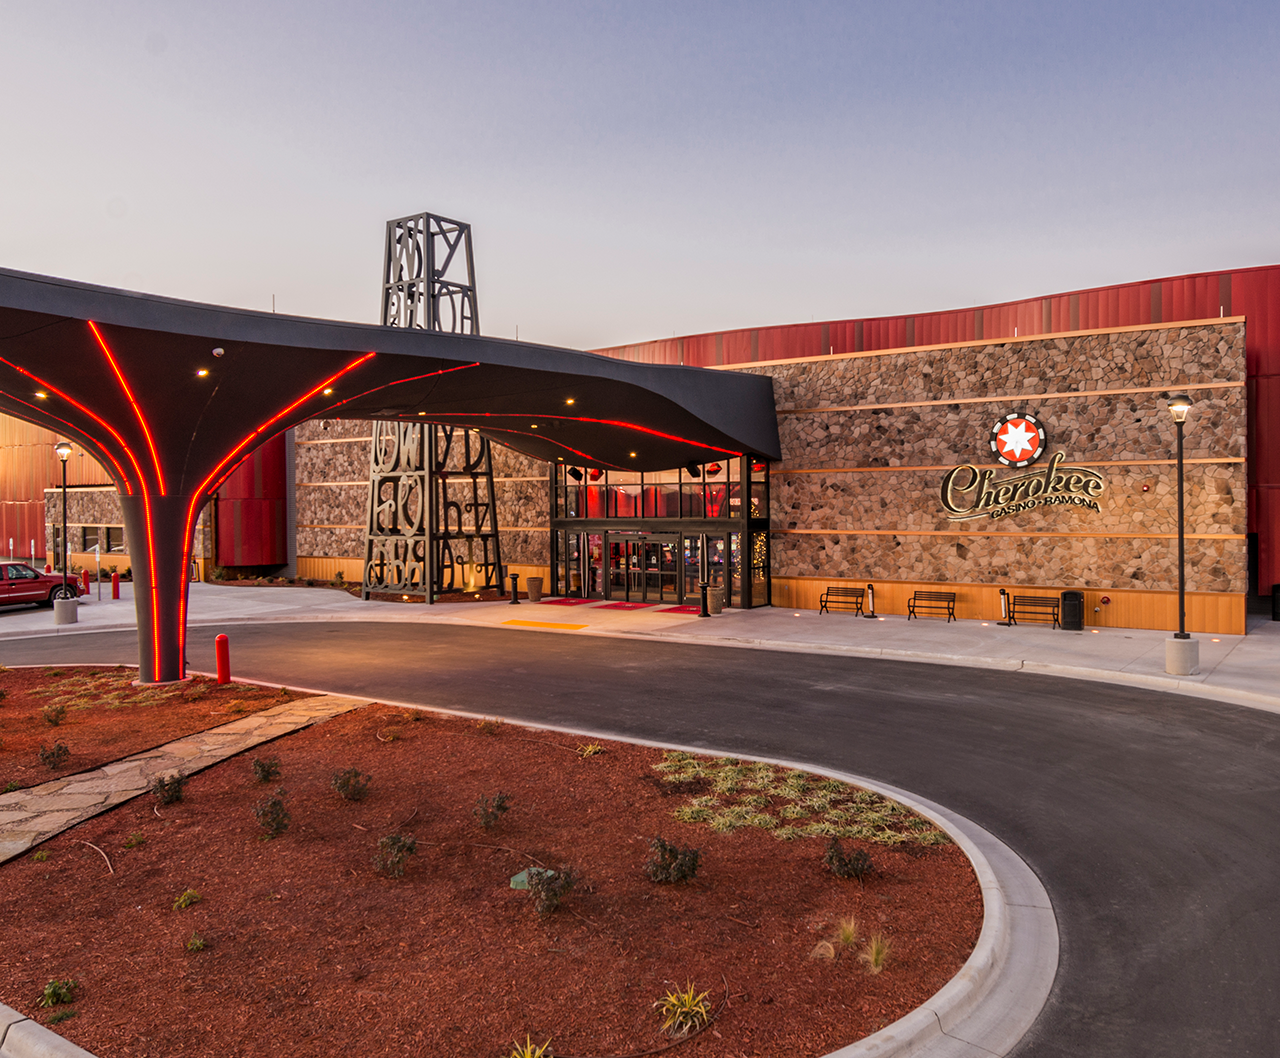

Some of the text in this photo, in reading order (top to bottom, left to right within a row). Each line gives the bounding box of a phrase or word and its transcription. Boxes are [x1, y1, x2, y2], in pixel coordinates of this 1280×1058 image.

[940, 451, 1103, 514] Cherokee
[990, 496, 1101, 519] CASINO RAMONA
